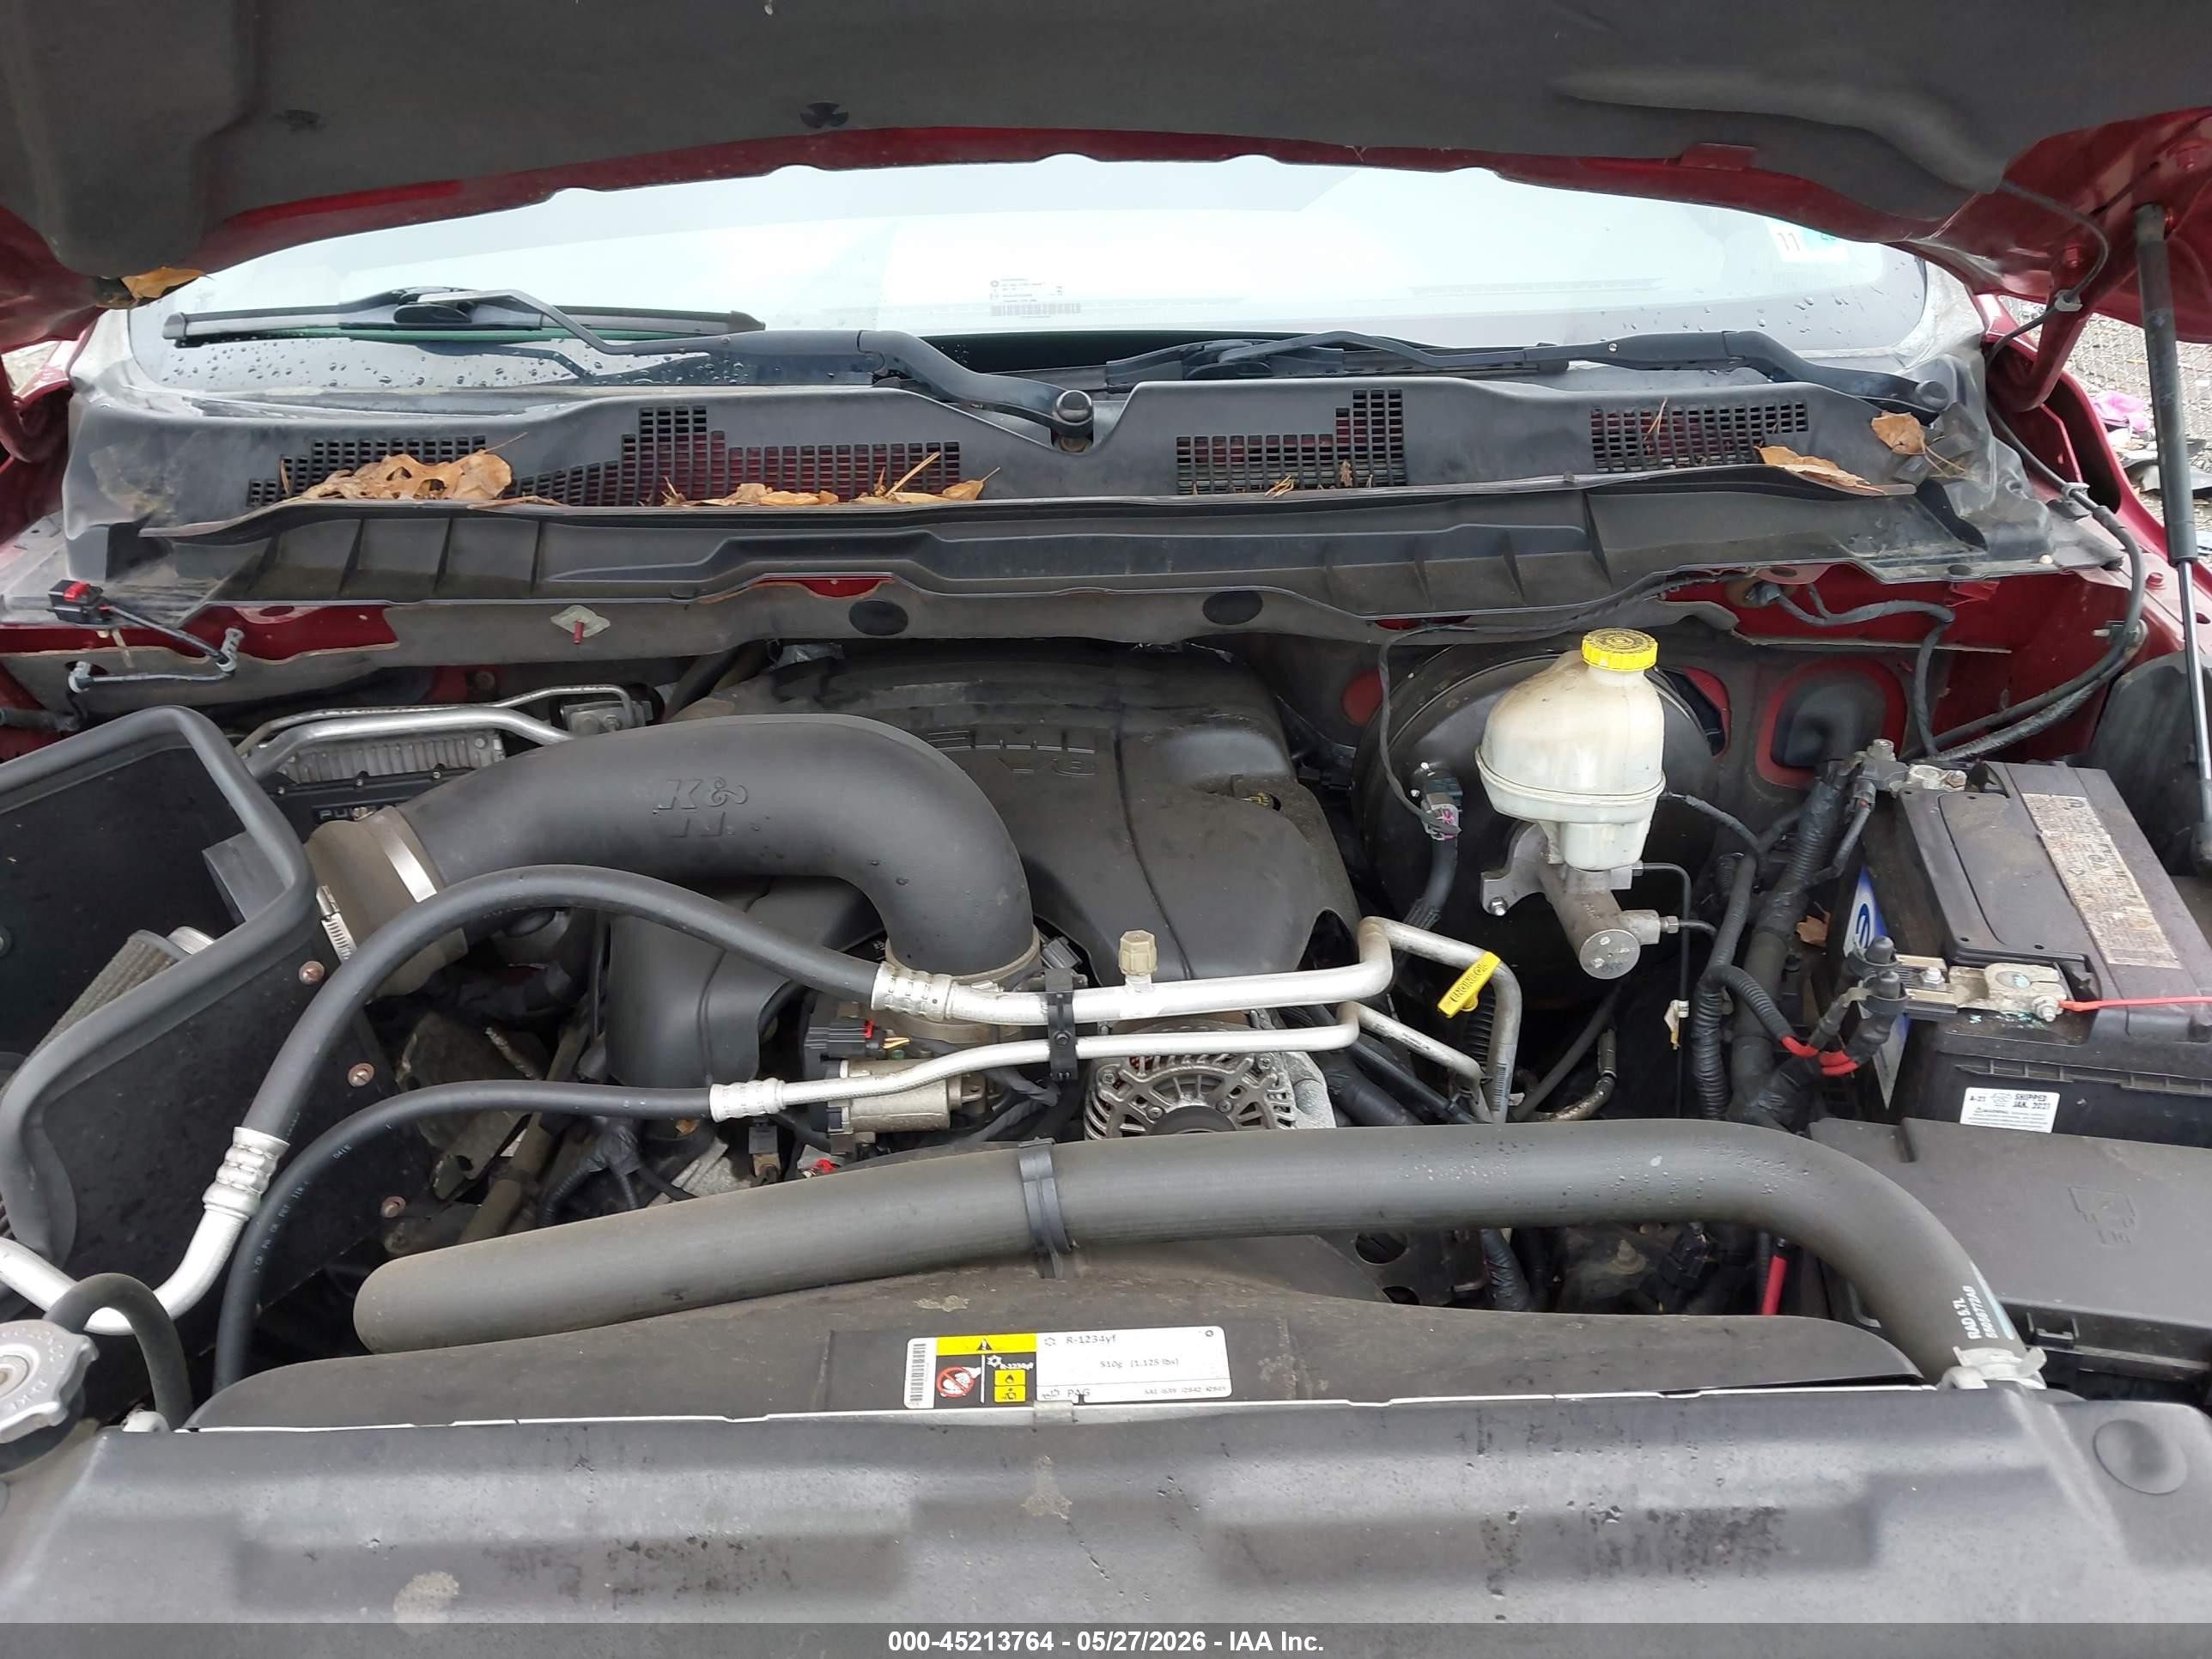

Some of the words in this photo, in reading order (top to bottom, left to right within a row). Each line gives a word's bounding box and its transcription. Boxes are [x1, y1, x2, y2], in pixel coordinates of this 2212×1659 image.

[2014, 1093, 2048, 1103] SHIPPED
[1952, 1297, 1972, 1316] 5.7L
[1960, 1316, 1983, 1340] RAD
[1066, 1333, 1117, 1346] R-1234yf
